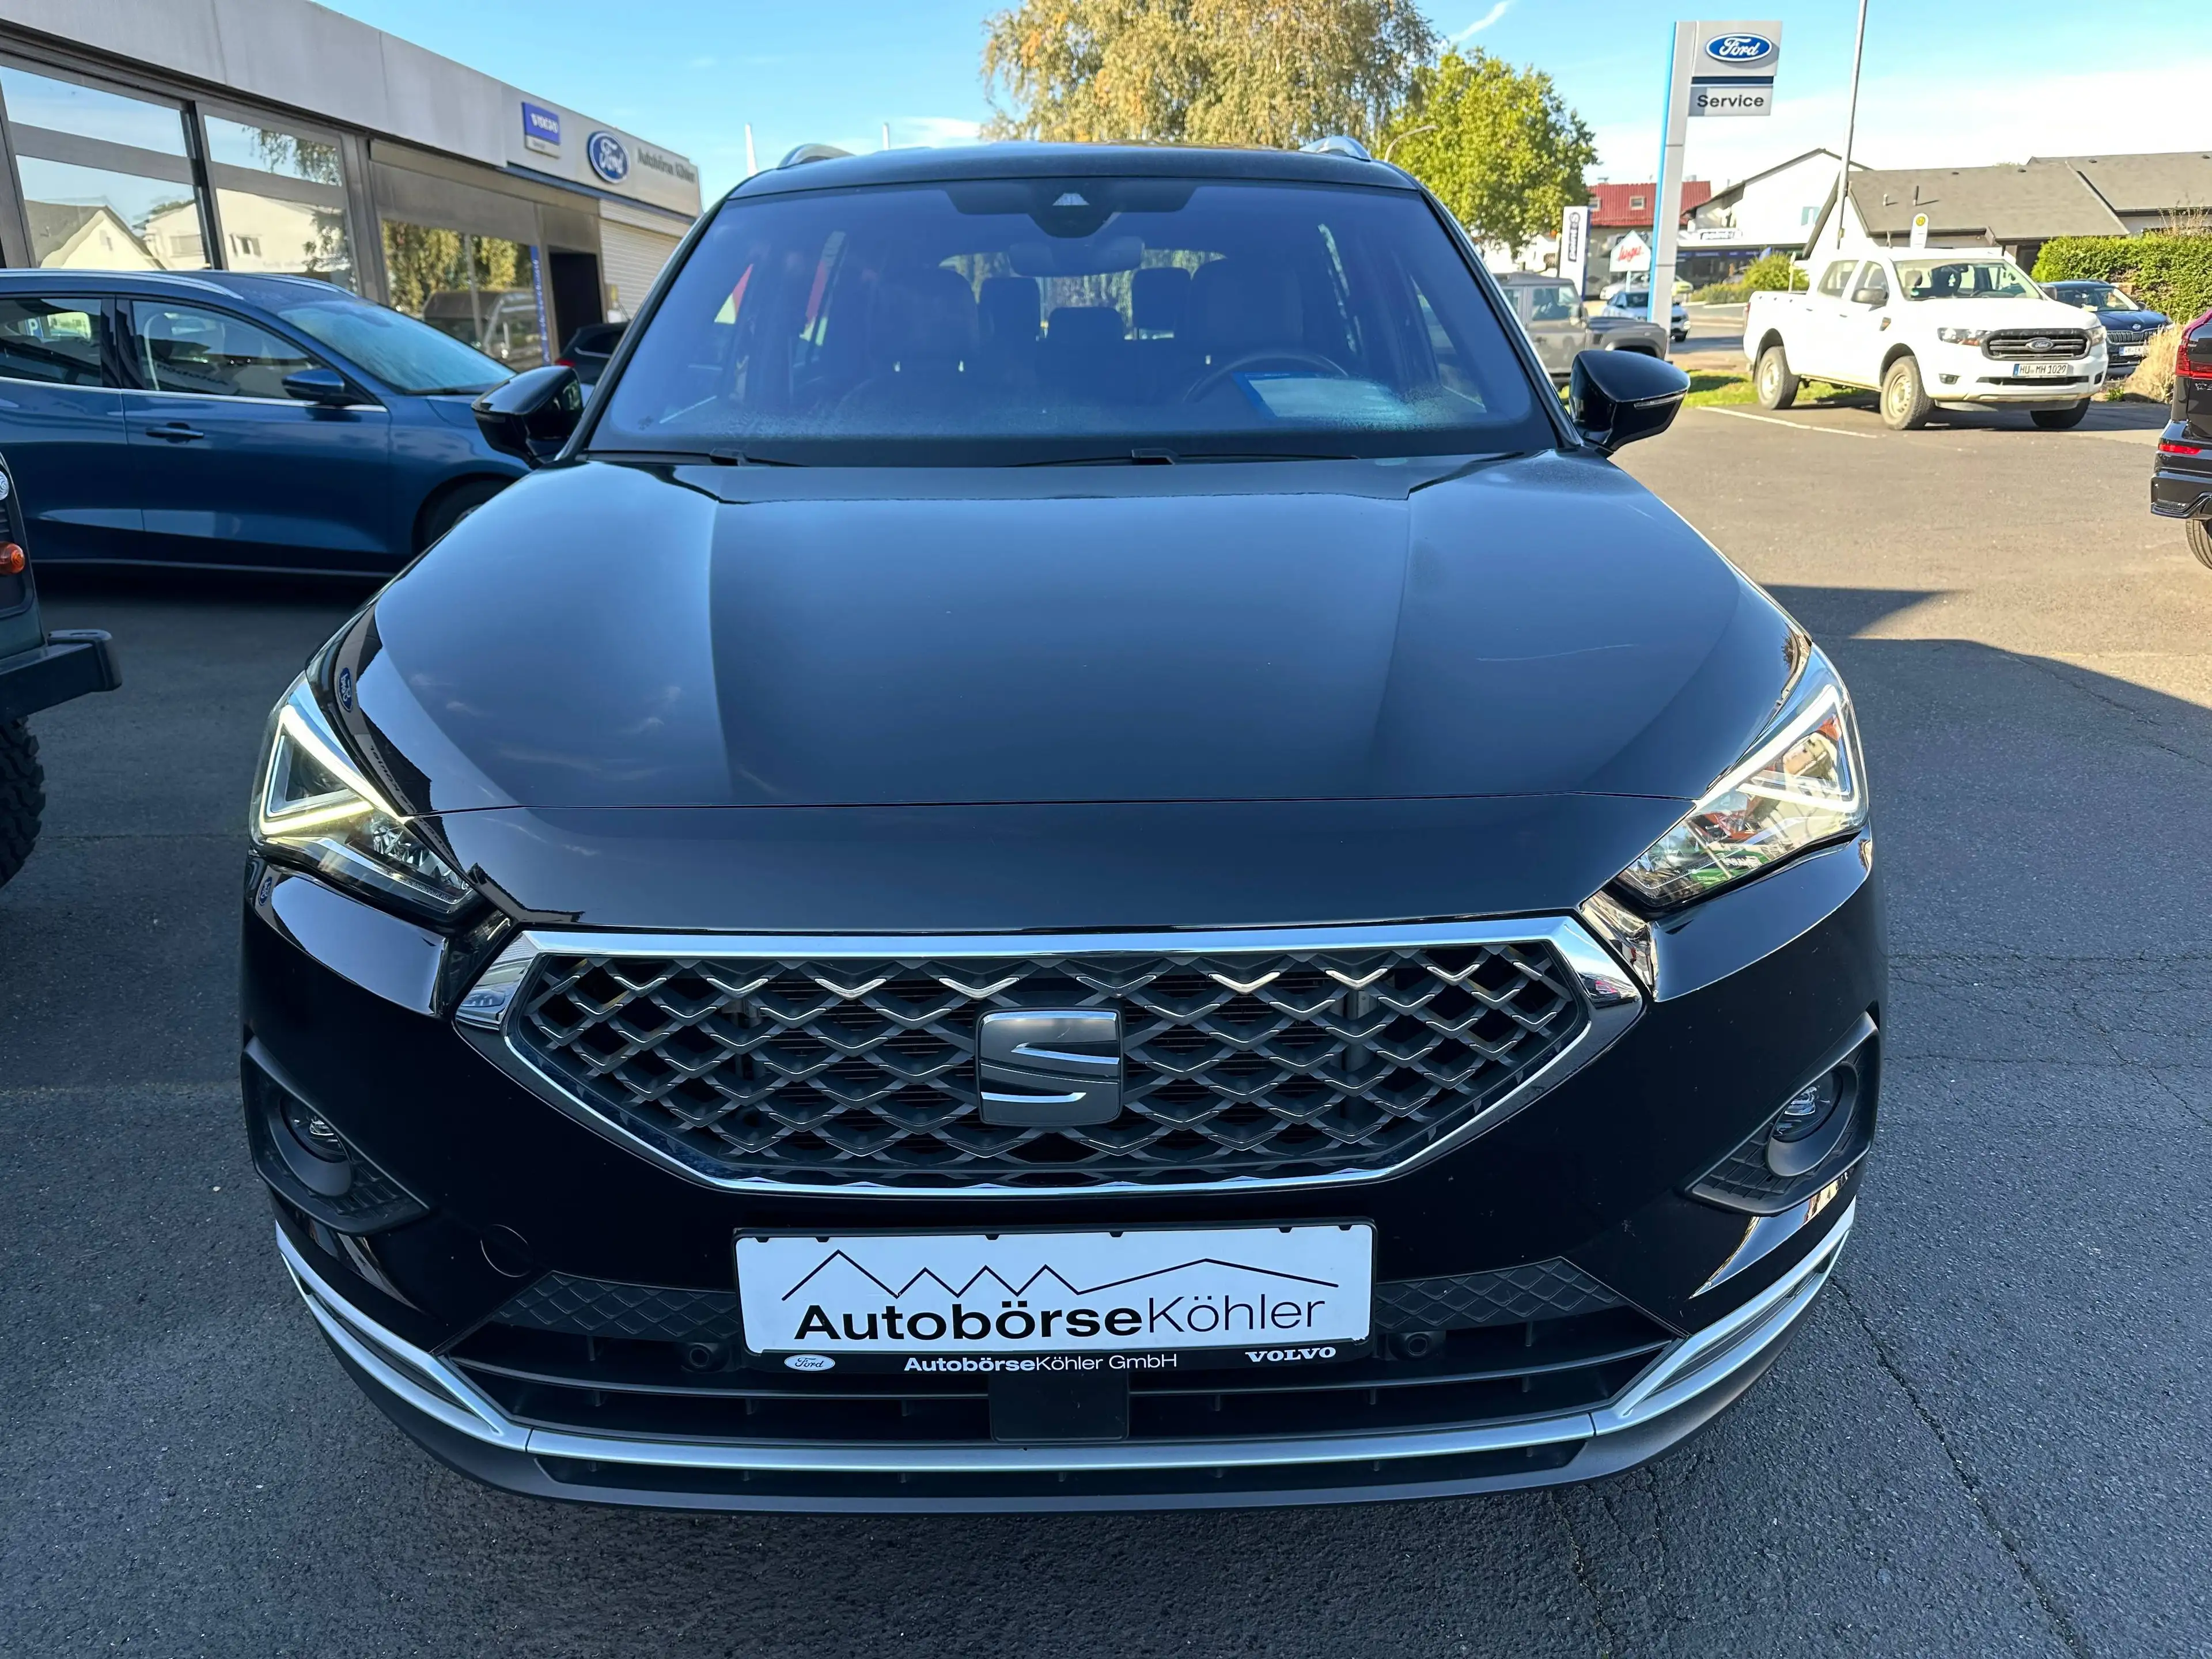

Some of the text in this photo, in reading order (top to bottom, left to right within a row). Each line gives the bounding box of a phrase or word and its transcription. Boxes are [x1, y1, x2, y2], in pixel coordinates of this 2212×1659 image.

[1719, 37, 1760, 56] Ford
[1697, 94, 1764, 107] Service
[599, 138, 624, 174] Ford
[29, 318, 38, 336] P
[2020, 365, 2067, 374] HU MH 1029
[1108, 1353, 1177, 1369] GmbH
[1245, 1346, 1336, 1363] VOLVO
[794, 1357, 824, 1369] Ford
